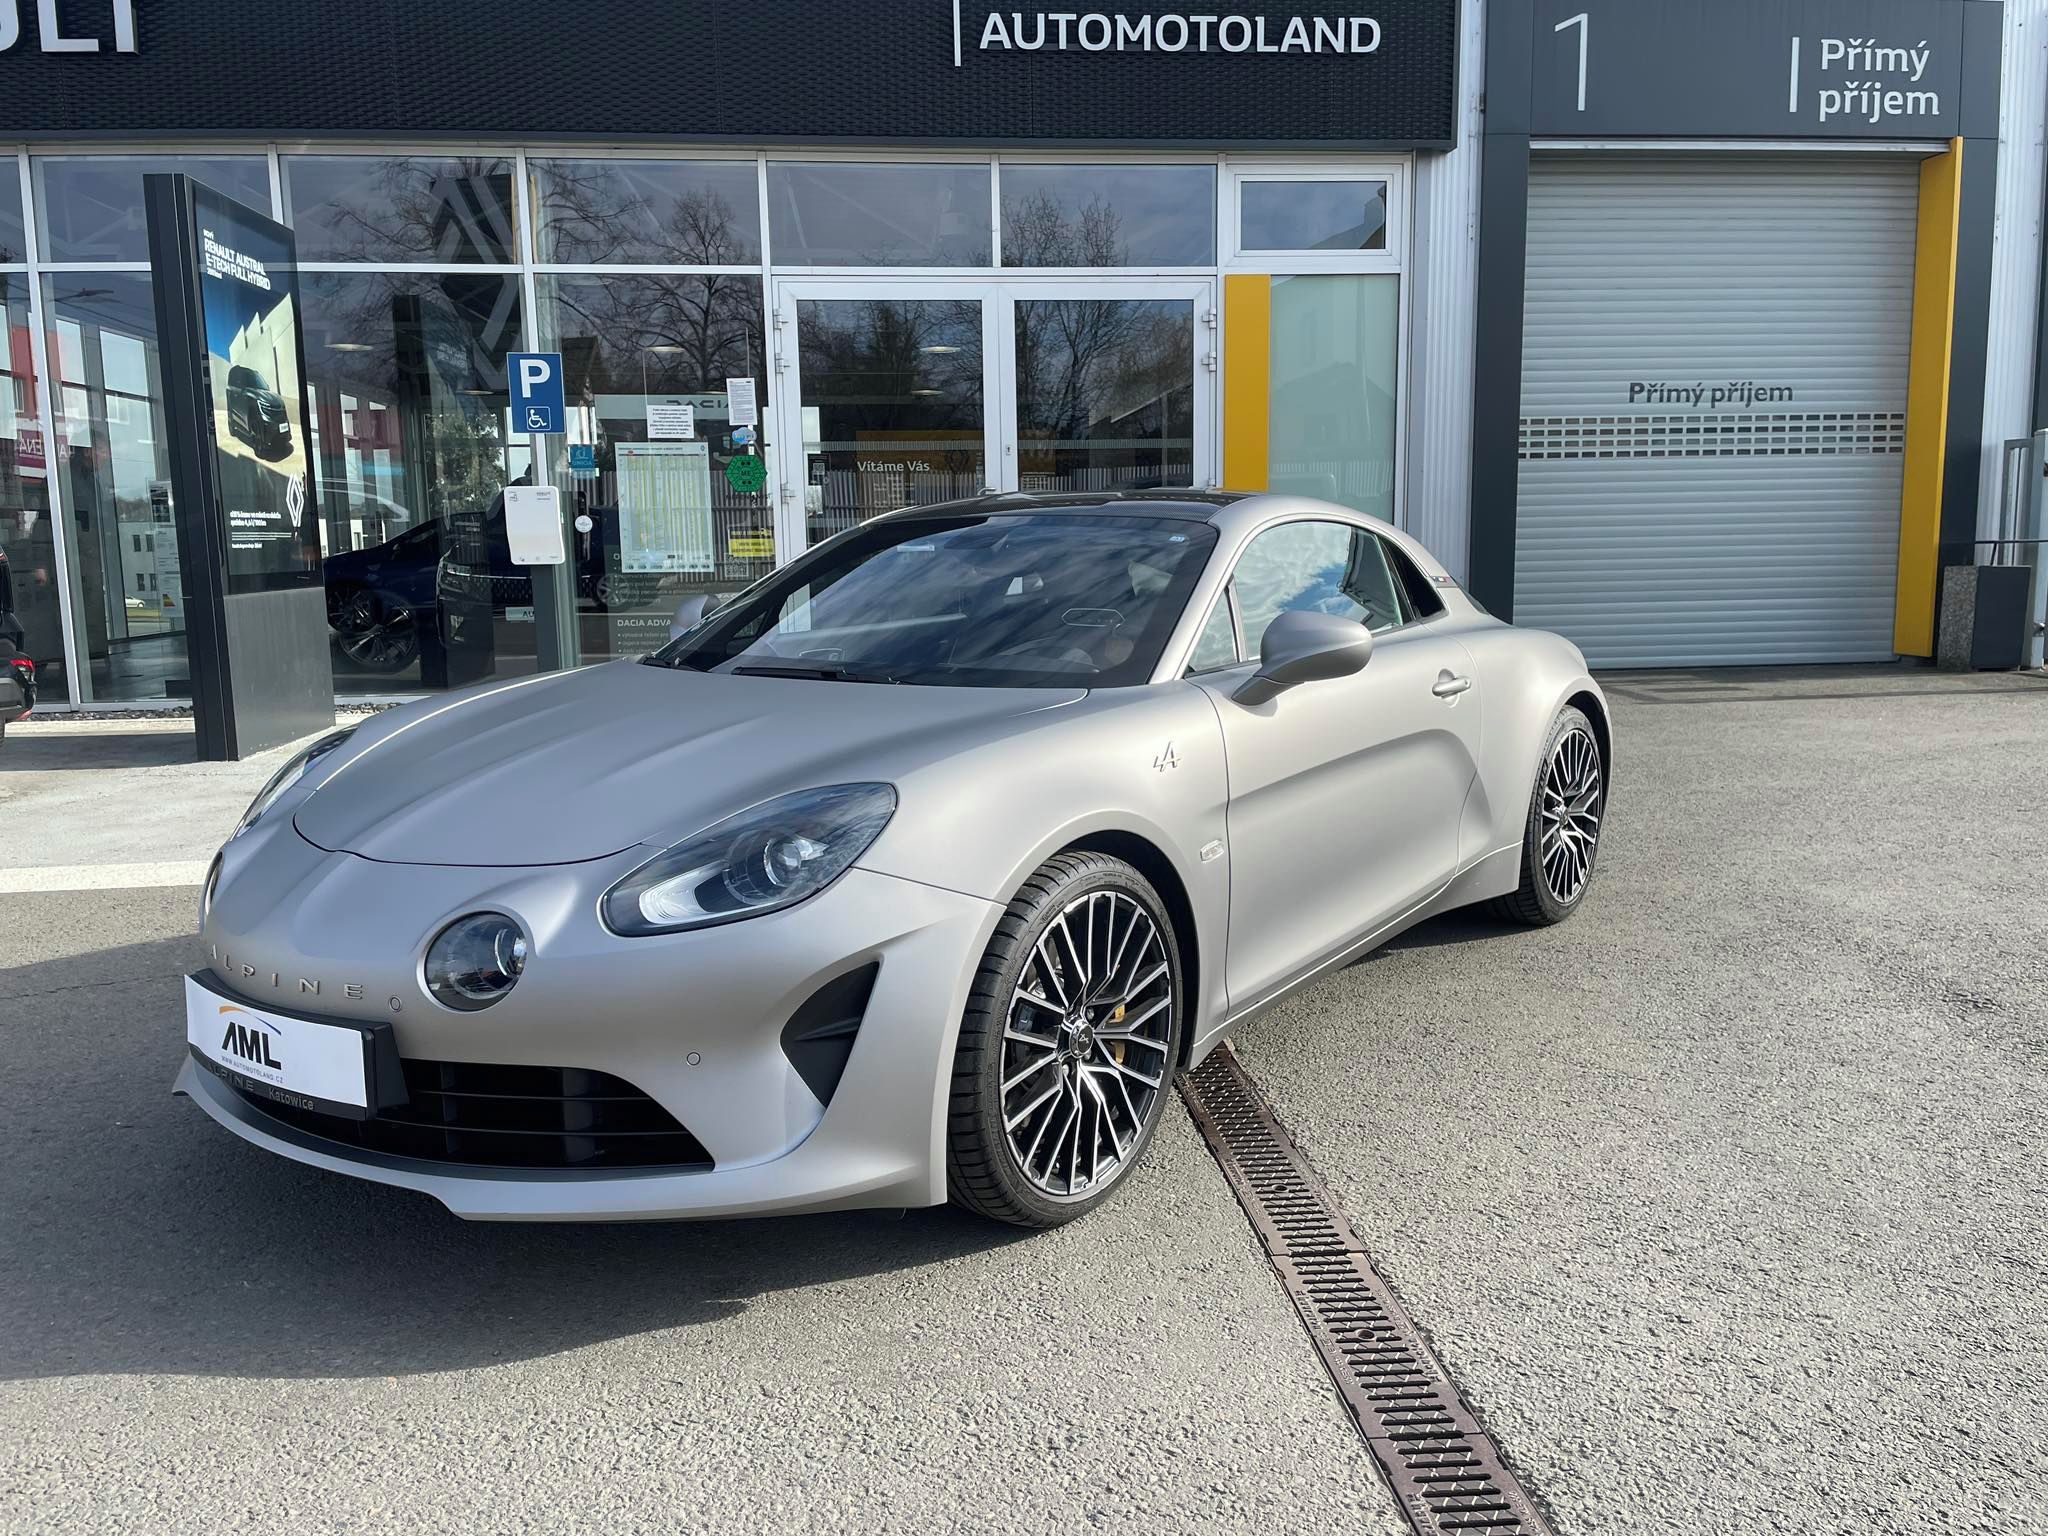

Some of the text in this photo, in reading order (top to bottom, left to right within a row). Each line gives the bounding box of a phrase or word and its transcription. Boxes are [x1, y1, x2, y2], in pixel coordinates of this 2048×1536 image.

[979, 12, 1382, 53] AUTOMOTOLAND
[1554, 13, 1590, 111] 1
[1819, 37, 1930, 81] Přímý
[1818, 82, 1940, 122] příjem
[204, 237, 235, 262] RENAULT
[235, 252, 267, 276] AUSTRAL
[205, 252, 231, 275] E-TECH
[230, 262, 249, 281] FULL
[247, 271, 272, 291] HYBRID
[519, 359, 551, 398] P
[1628, 382, 1794, 409] Přímý příjem
[857, 460, 930, 472] Vítáme Vás
[617, 619, 645, 627] DACIA
[210, 943, 364, 1000] ALPINE
[221, 1021, 282, 1071] AML
[208, 1062, 315, 1111] ALPINE Katowice
